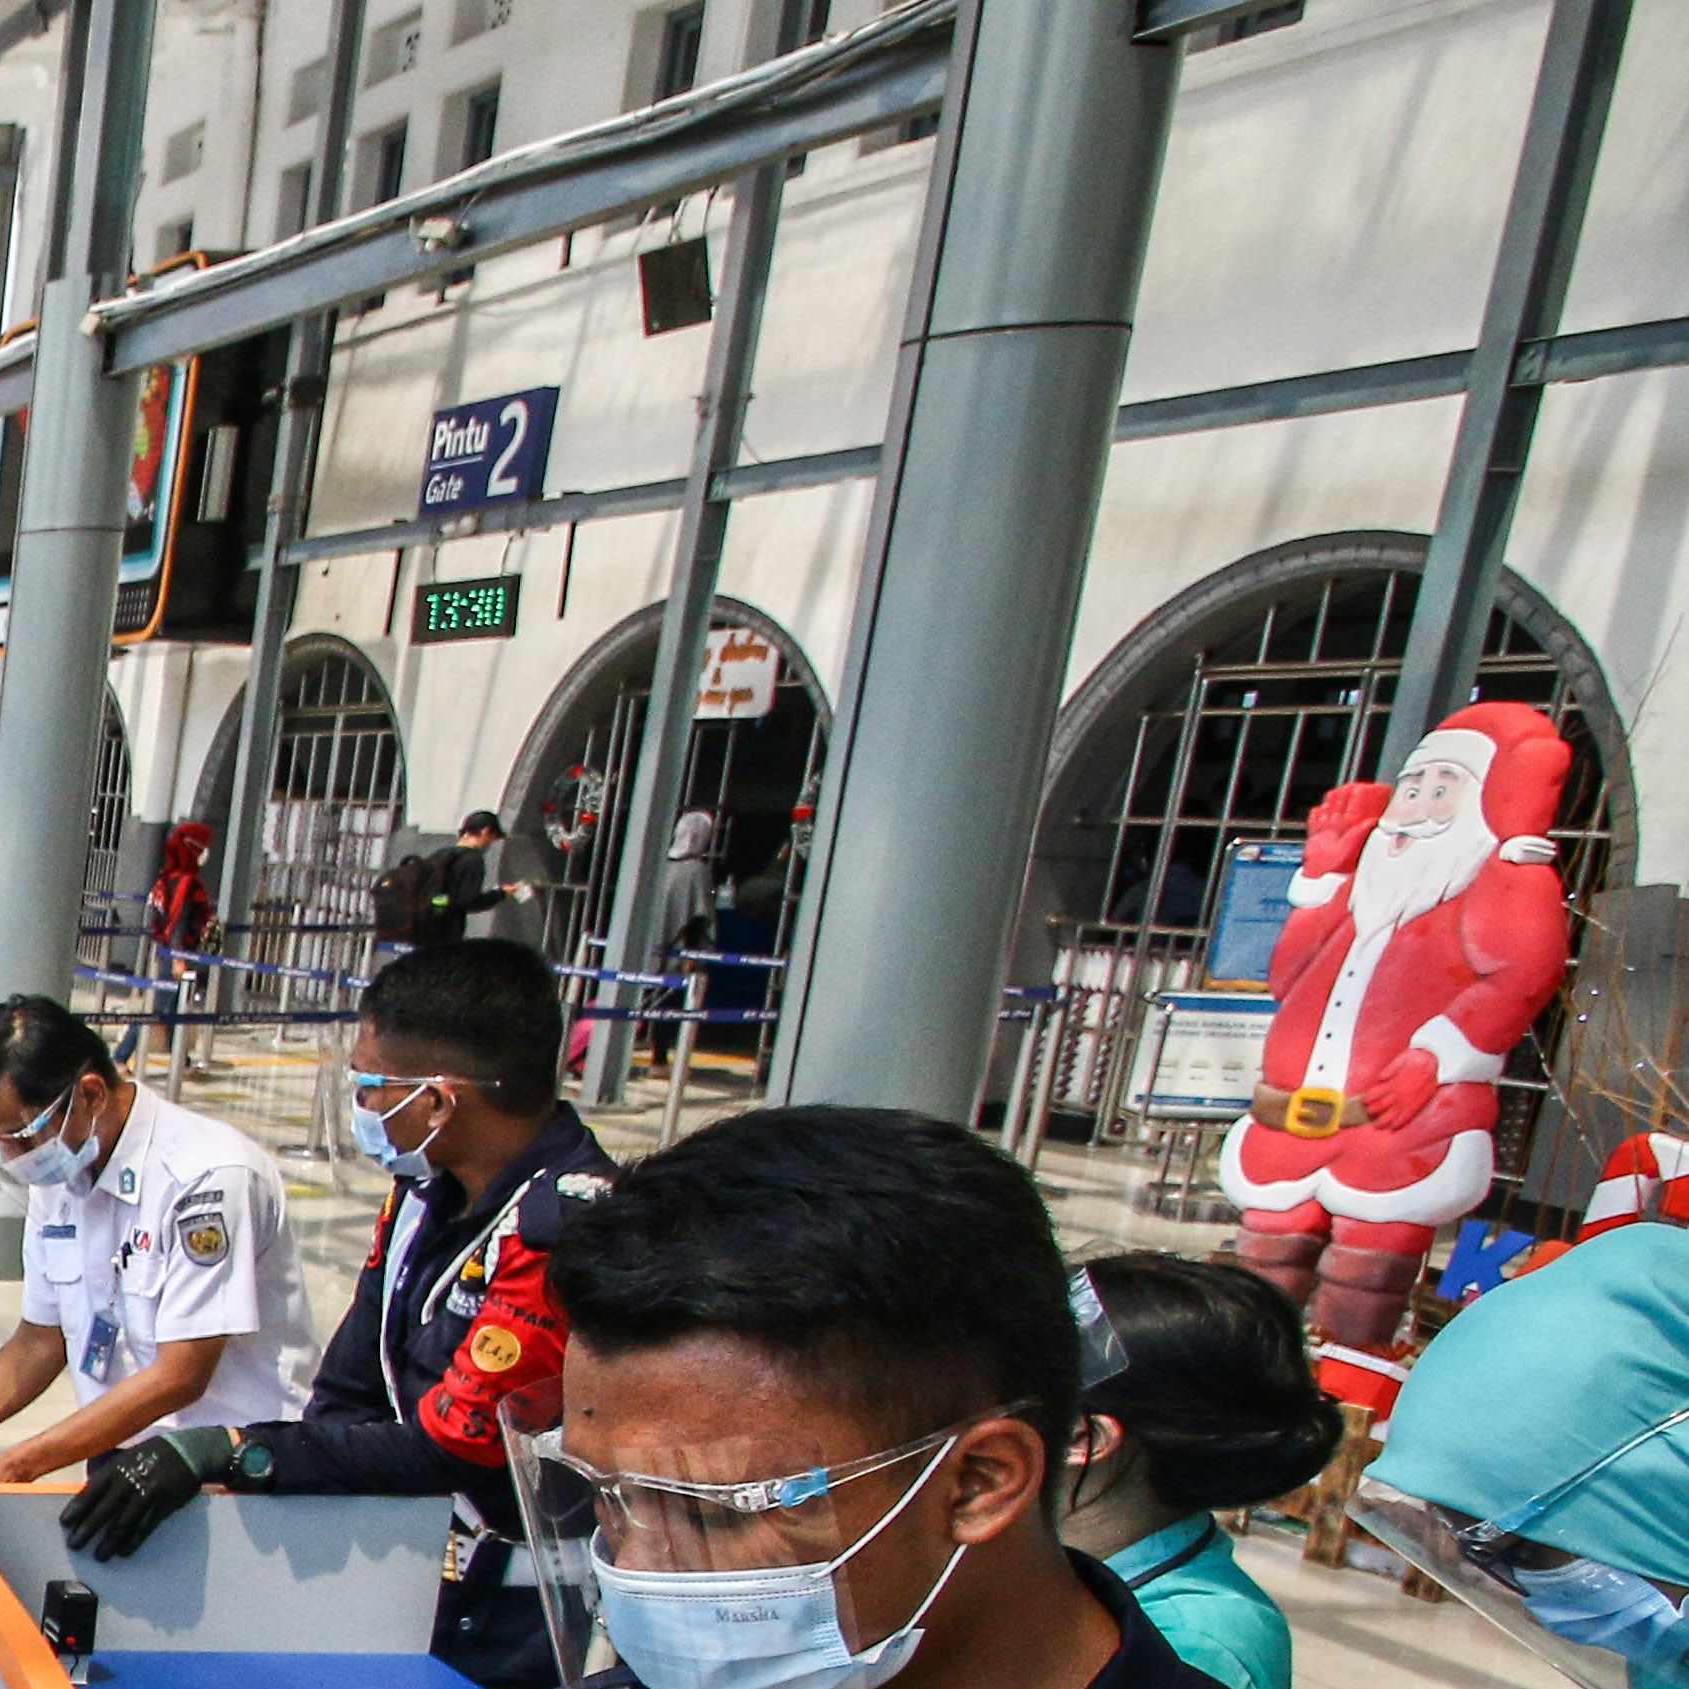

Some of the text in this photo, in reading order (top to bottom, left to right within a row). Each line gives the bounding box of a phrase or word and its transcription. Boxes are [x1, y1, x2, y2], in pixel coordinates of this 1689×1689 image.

[431, 415, 491, 461] Pintu
[485, 400, 529, 498] 2
[425, 473, 465, 505] Gate
